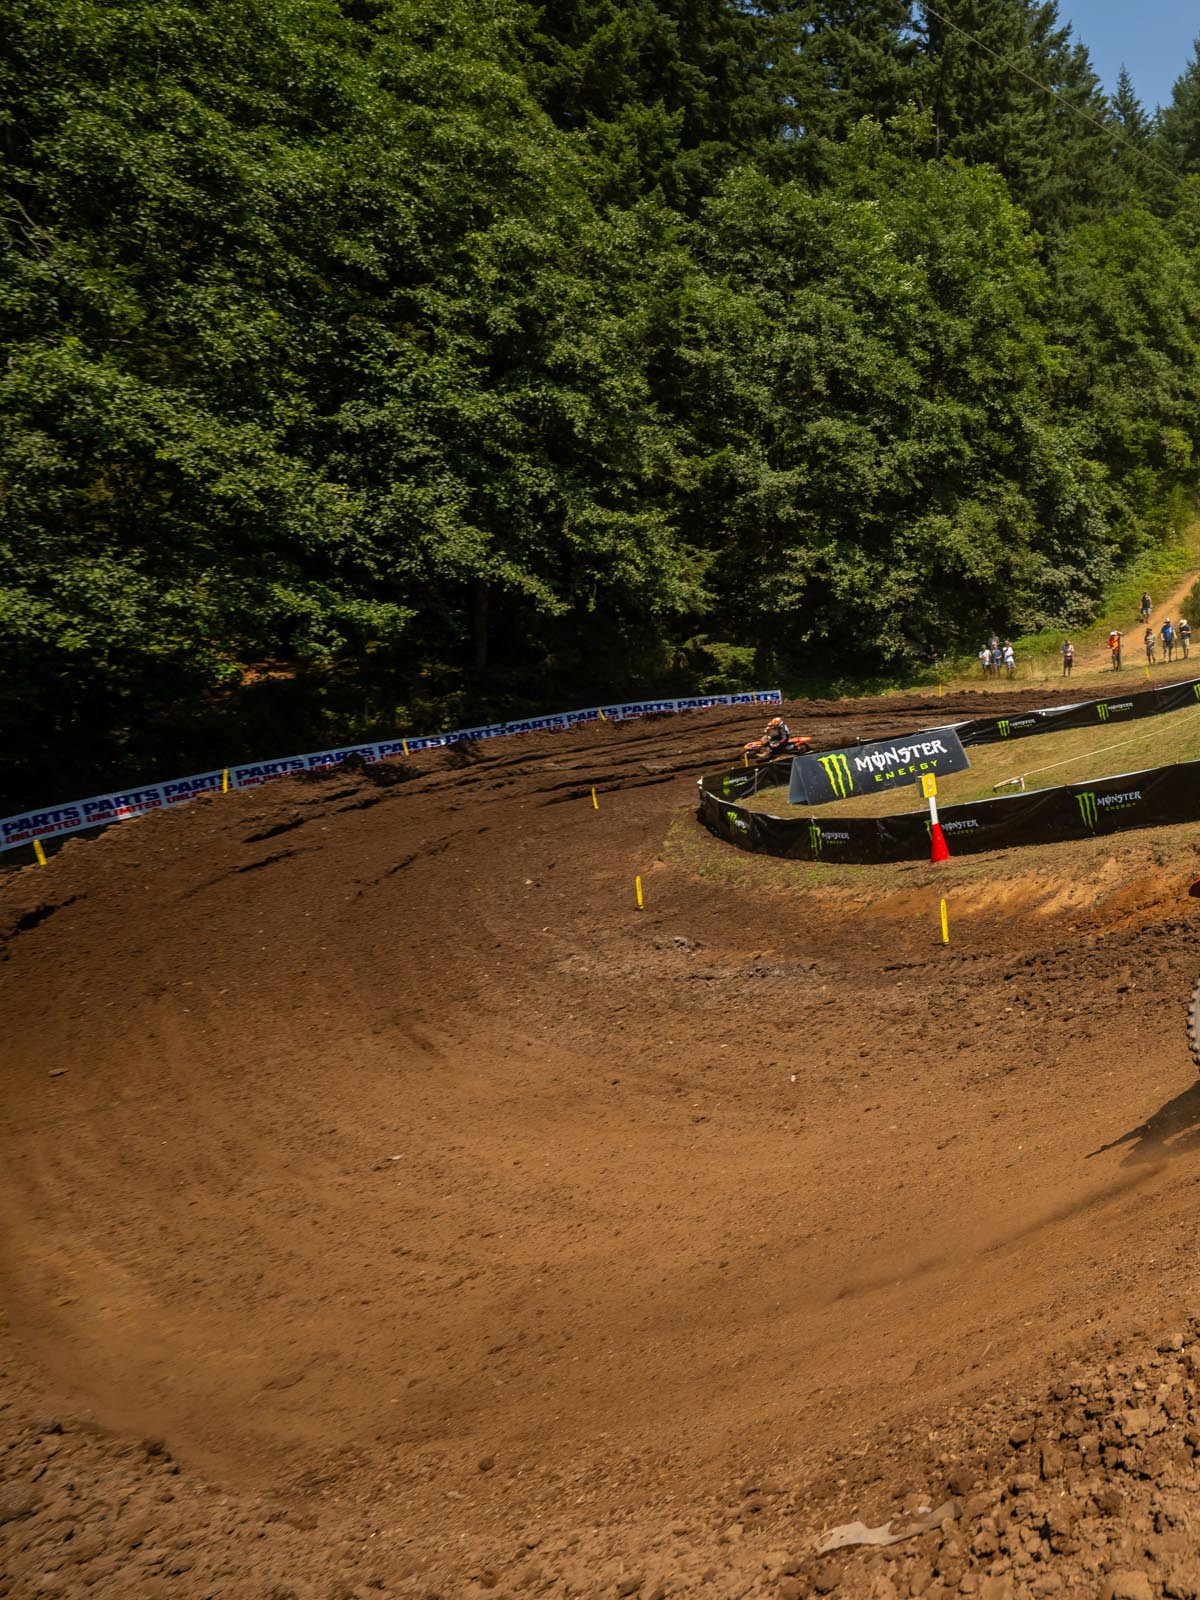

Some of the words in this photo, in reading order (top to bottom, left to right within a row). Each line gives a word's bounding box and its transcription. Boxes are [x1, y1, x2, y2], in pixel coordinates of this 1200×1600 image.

[677, 696, 727, 708] PARTS
[731, 692, 779, 704] PARTS
[622, 702, 674, 714] PARTS
[509, 715, 563, 733] PARTS
[446, 726, 506, 744] PARTS
[378, 738, 443, 753] PARTS
[854, 740, 947, 772] MONSTER
[235, 759, 304, 781] PARTS
[874, 760, 938, 782] ENERGY
[81, 788, 160, 815] PARTS
[1096, 790, 1142, 807] MONSTER
[86, 800, 162, 823] UNLIMITED
[2, 806, 80, 836] PARTS
[941, 818, 980, 832] MONSTER
[5, 818, 82, 844] UNLIMITED
